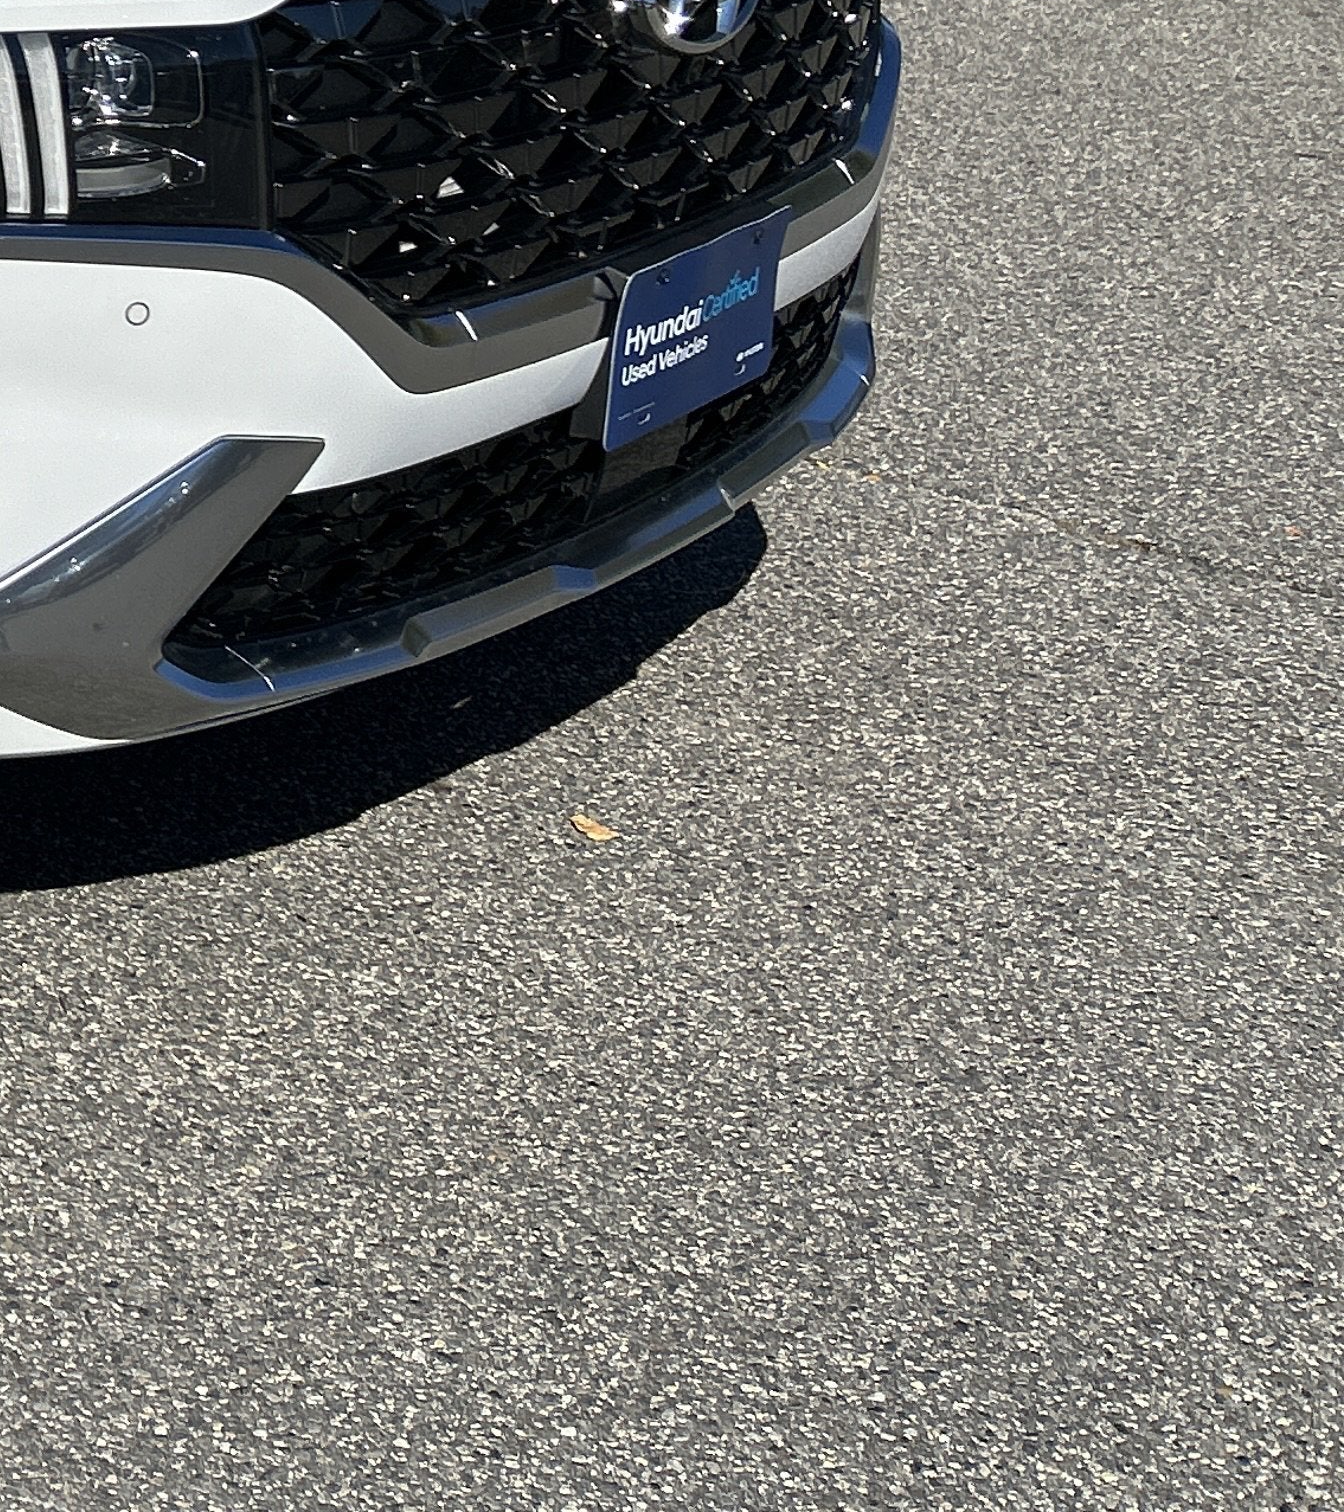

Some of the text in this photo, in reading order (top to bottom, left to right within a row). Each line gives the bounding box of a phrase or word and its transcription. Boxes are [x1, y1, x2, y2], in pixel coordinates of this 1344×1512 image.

[623, 298, 704, 356] Hyundai
[621, 353, 658, 387] Used
[658, 334, 709, 371] Vehicles
